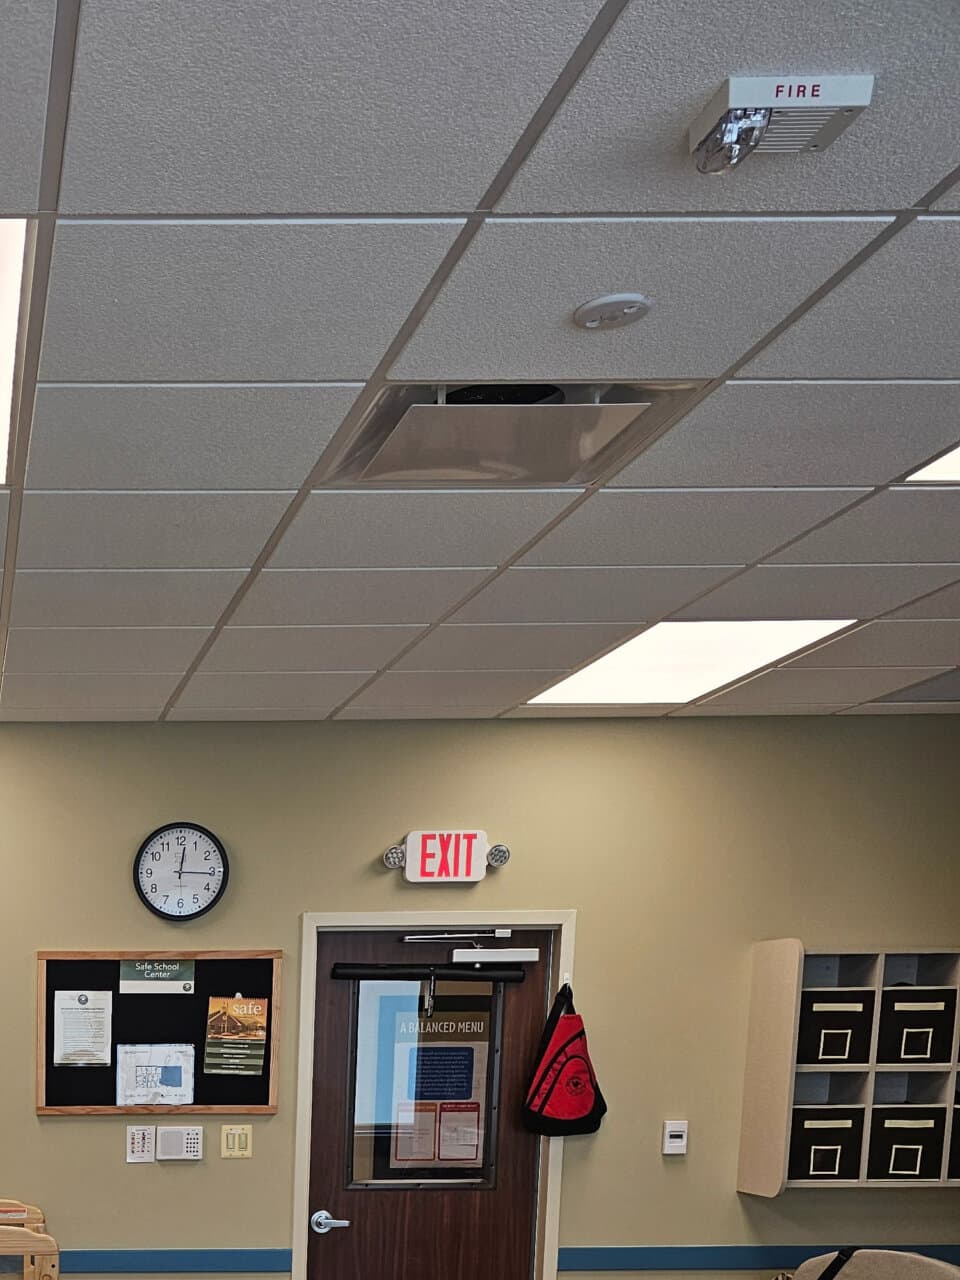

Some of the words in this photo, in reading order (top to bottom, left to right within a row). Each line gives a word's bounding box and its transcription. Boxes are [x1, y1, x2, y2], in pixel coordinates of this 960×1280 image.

[775, 84, 821, 98] FIRE
[175, 836, 187, 846] 12
[160, 842, 170, 852] 11
[150, 851, 161, 862] 10
[204, 850, 211, 861] 2
[420, 833, 477, 878] EXIT
[145, 868, 153, 878] 9
[209, 866, 216, 877] 3
[150, 883, 157, 893] 8
[204, 882, 211, 891] 4
[162, 895, 169, 905] 7
[177, 898, 184, 909] 6
[192, 894, 199, 904] 5
[135, 962, 152, 971] Safe
[153, 962, 180, 971] School
[144, 970, 171, 978] Center
[232, 1001, 262, 1015] safe
[400, 1021, 407, 1032] A
[408, 1021, 456, 1033] BALANCED
[457, 1021, 484, 1033] MENU
